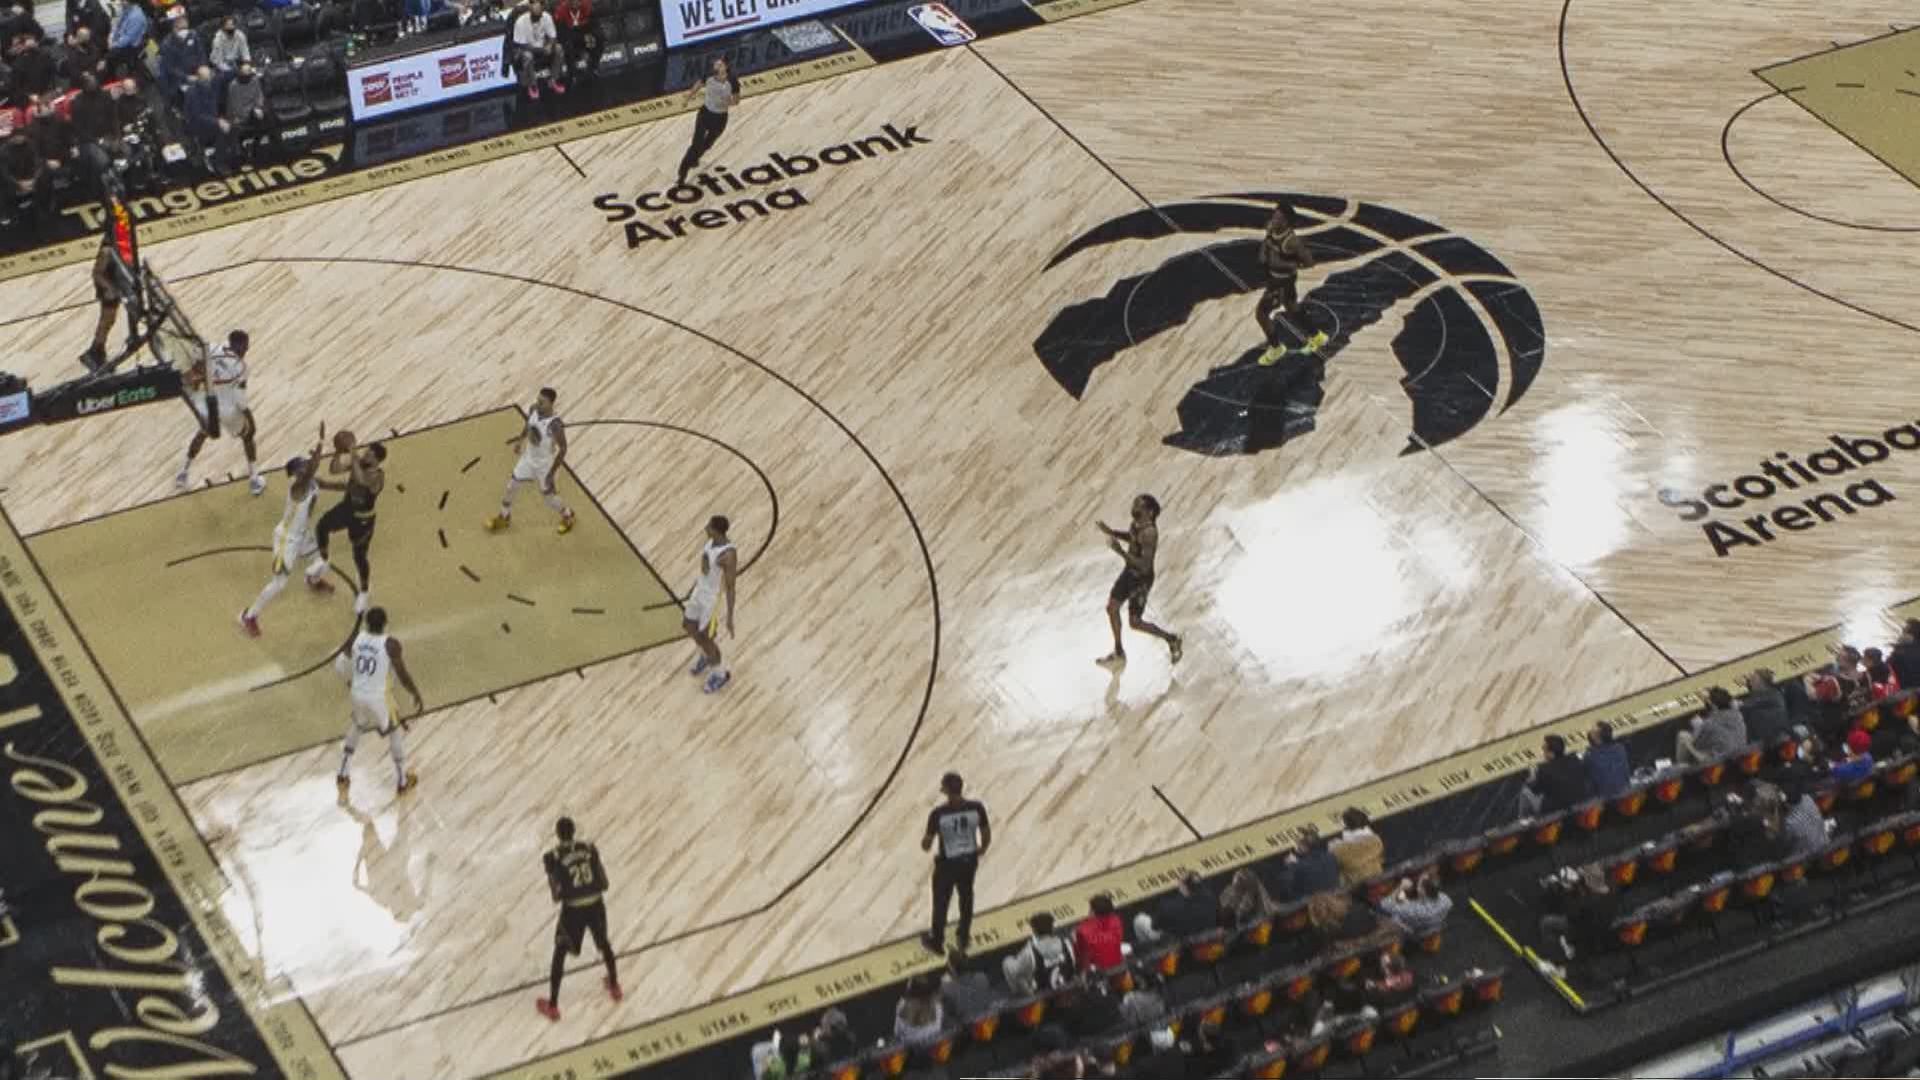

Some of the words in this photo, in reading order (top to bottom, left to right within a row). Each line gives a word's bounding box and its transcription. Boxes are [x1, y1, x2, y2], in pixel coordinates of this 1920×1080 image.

[680, 0, 715, 28] WE
[593, 123, 933, 223] Scotiabank
[624, 187, 810, 249] Arena
[77, 396, 115, 415] Uber
[1702, 478, 1897, 558] Arena
[356, 655, 377, 676] 00
[5, 741, 258, 1080] Welcome
